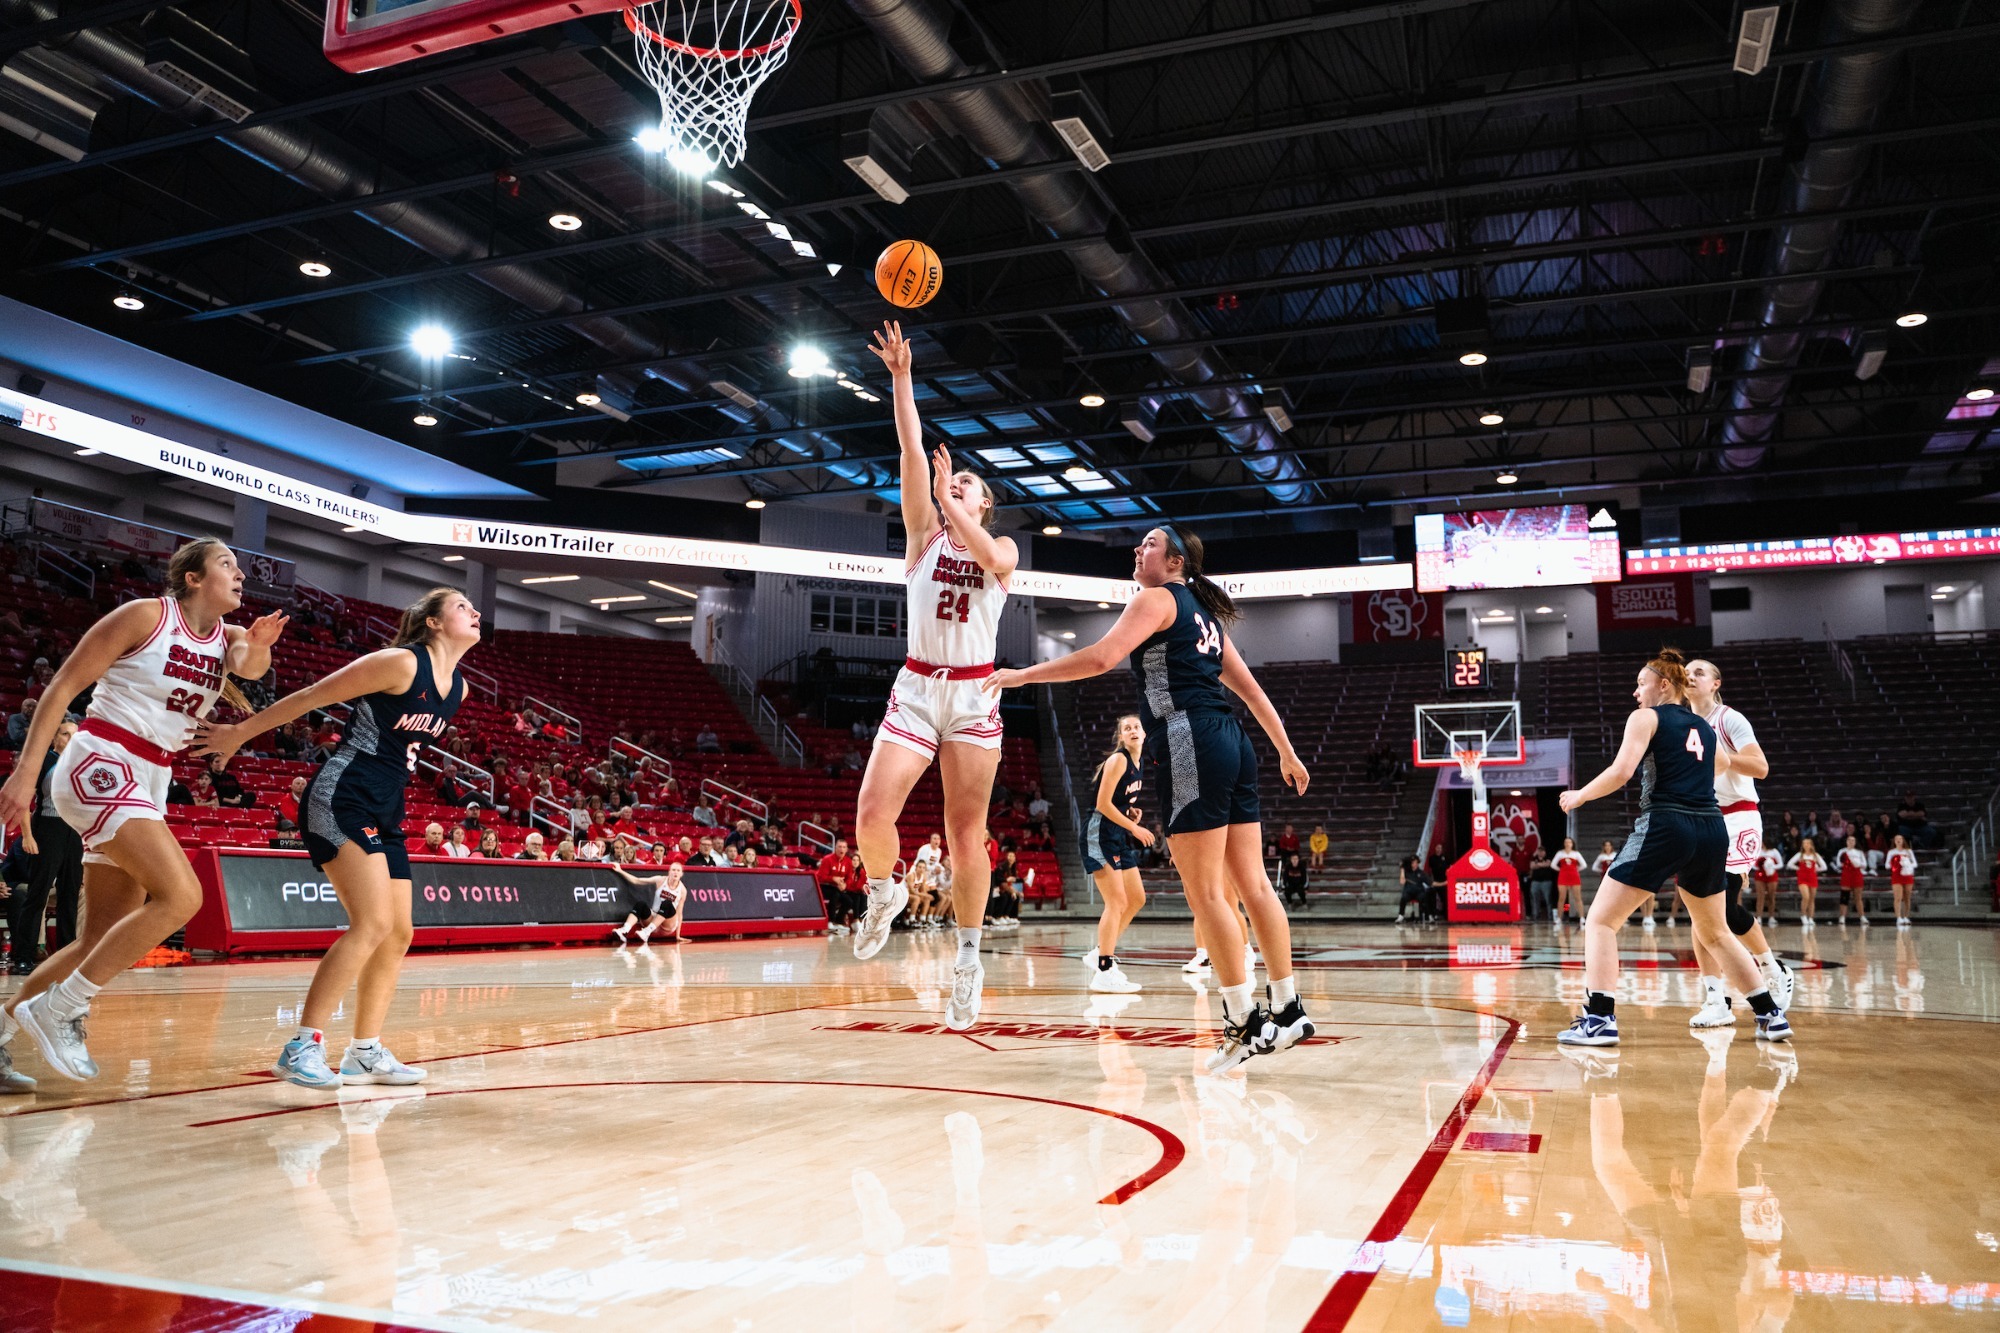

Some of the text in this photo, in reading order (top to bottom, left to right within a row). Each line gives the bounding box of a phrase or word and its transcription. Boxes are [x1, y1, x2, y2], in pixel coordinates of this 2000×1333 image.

[130, 414, 146, 426] 107
[159, 449, 380, 525] BUILD WORLD CLASS TRAILERS!
[53, 508, 93, 526] VOLLEYBALL
[62, 522, 82, 536] 2016
[127, 525, 158, 540] VOLLEYBALL
[828, 561, 885, 574] LENNOX
[937, 554, 985, 577] SOUTH
[837, 581, 882, 594] SPORTS
[932, 568, 984, 590] DAKOTA
[1033, 579, 1063, 590] CITY
[1620, 588, 1676, 601] SOUTH
[936, 590, 970, 623] 24
[1619, 599, 1677, 611] DAKOTA
[1194, 612, 1222, 657] 34
[168, 643, 224, 677] SOUTH
[162, 661, 223, 693] DAKOTA
[1455, 663, 1480, 685] 22
[1685, 728, 1704, 761] 4
[406, 741, 422, 772] 5
[282, 882, 338, 902] POE
[423, 885, 519, 903] GO YOTES!
[573, 886, 619, 902] POET
[690, 888, 732, 903] YOTES!
[763, 888, 795, 902] POET
[1455, 882, 1510, 894] SOUTH
[1455, 893, 1510, 904] DAKOTA
